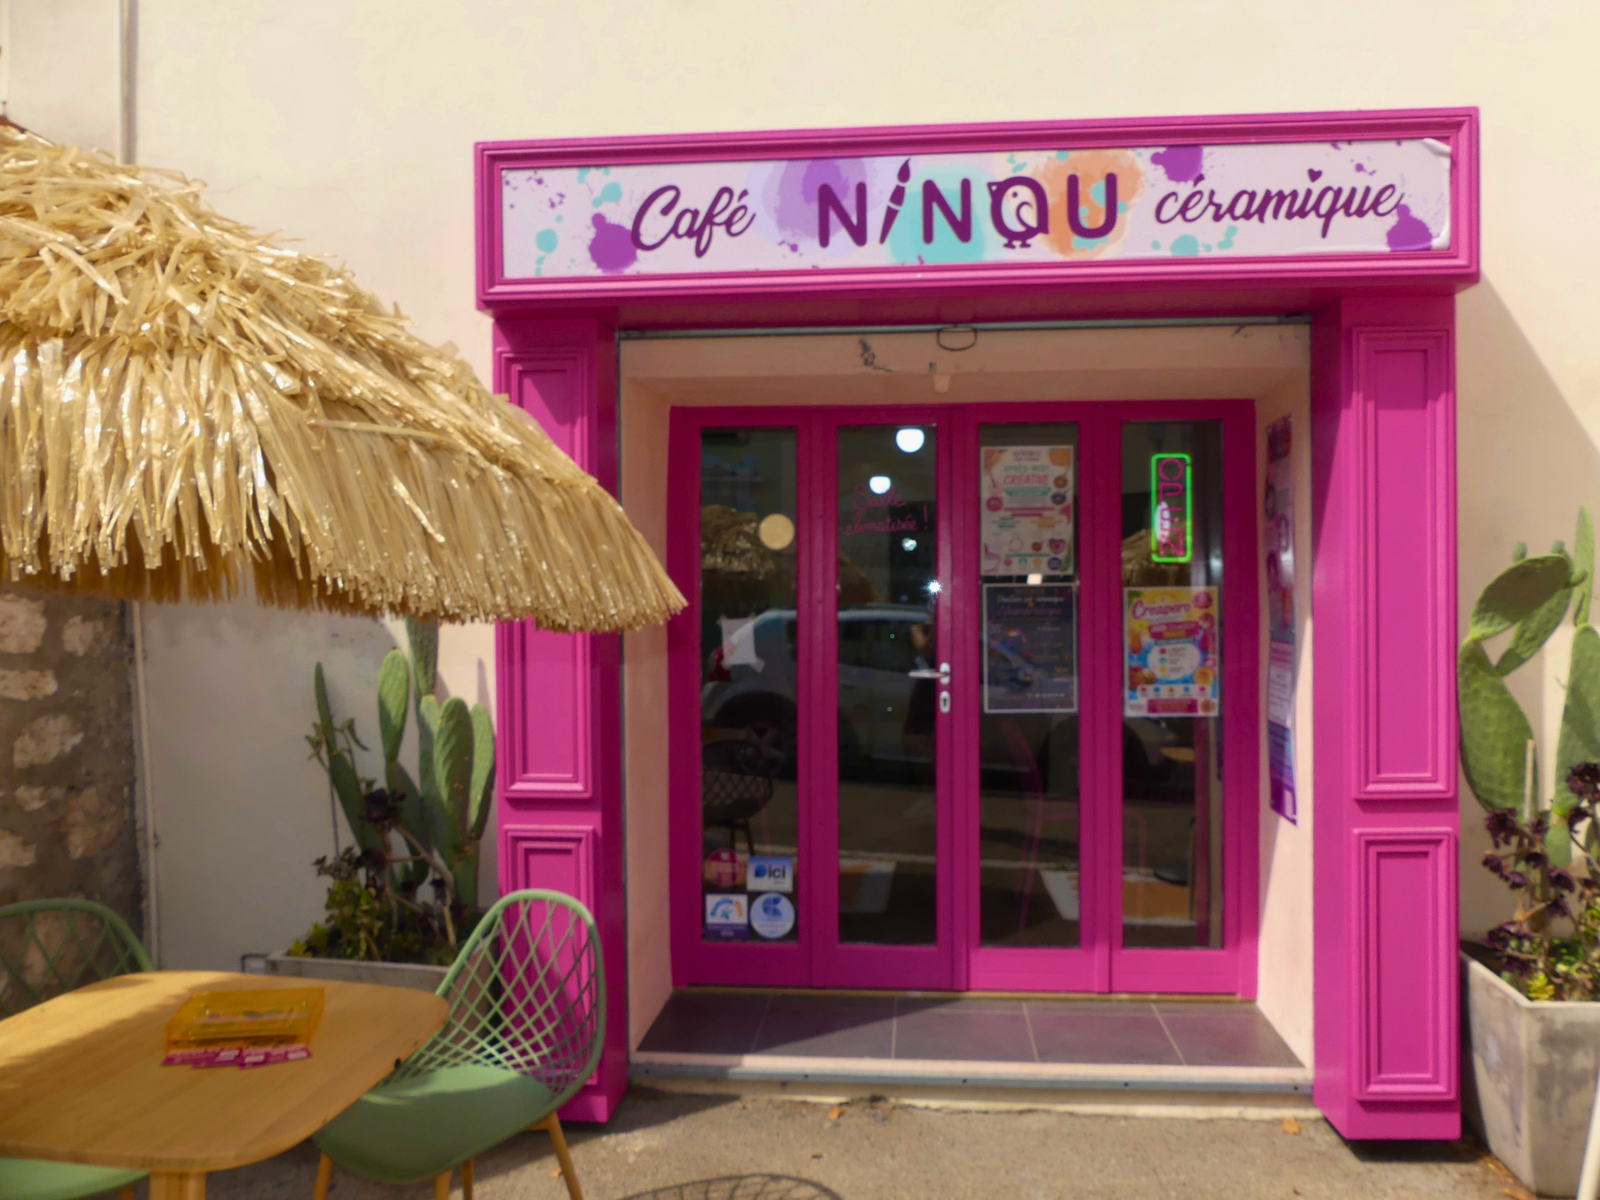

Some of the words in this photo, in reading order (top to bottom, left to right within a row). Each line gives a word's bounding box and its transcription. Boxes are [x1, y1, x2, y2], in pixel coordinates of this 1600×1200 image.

[631, 184, 756, 258] Café
[1155, 168, 1405, 239] céramique
[853, 483, 907, 511] Salle
[1158, 457, 1185, 557] OPEN
[768, 864, 786, 879] ici
